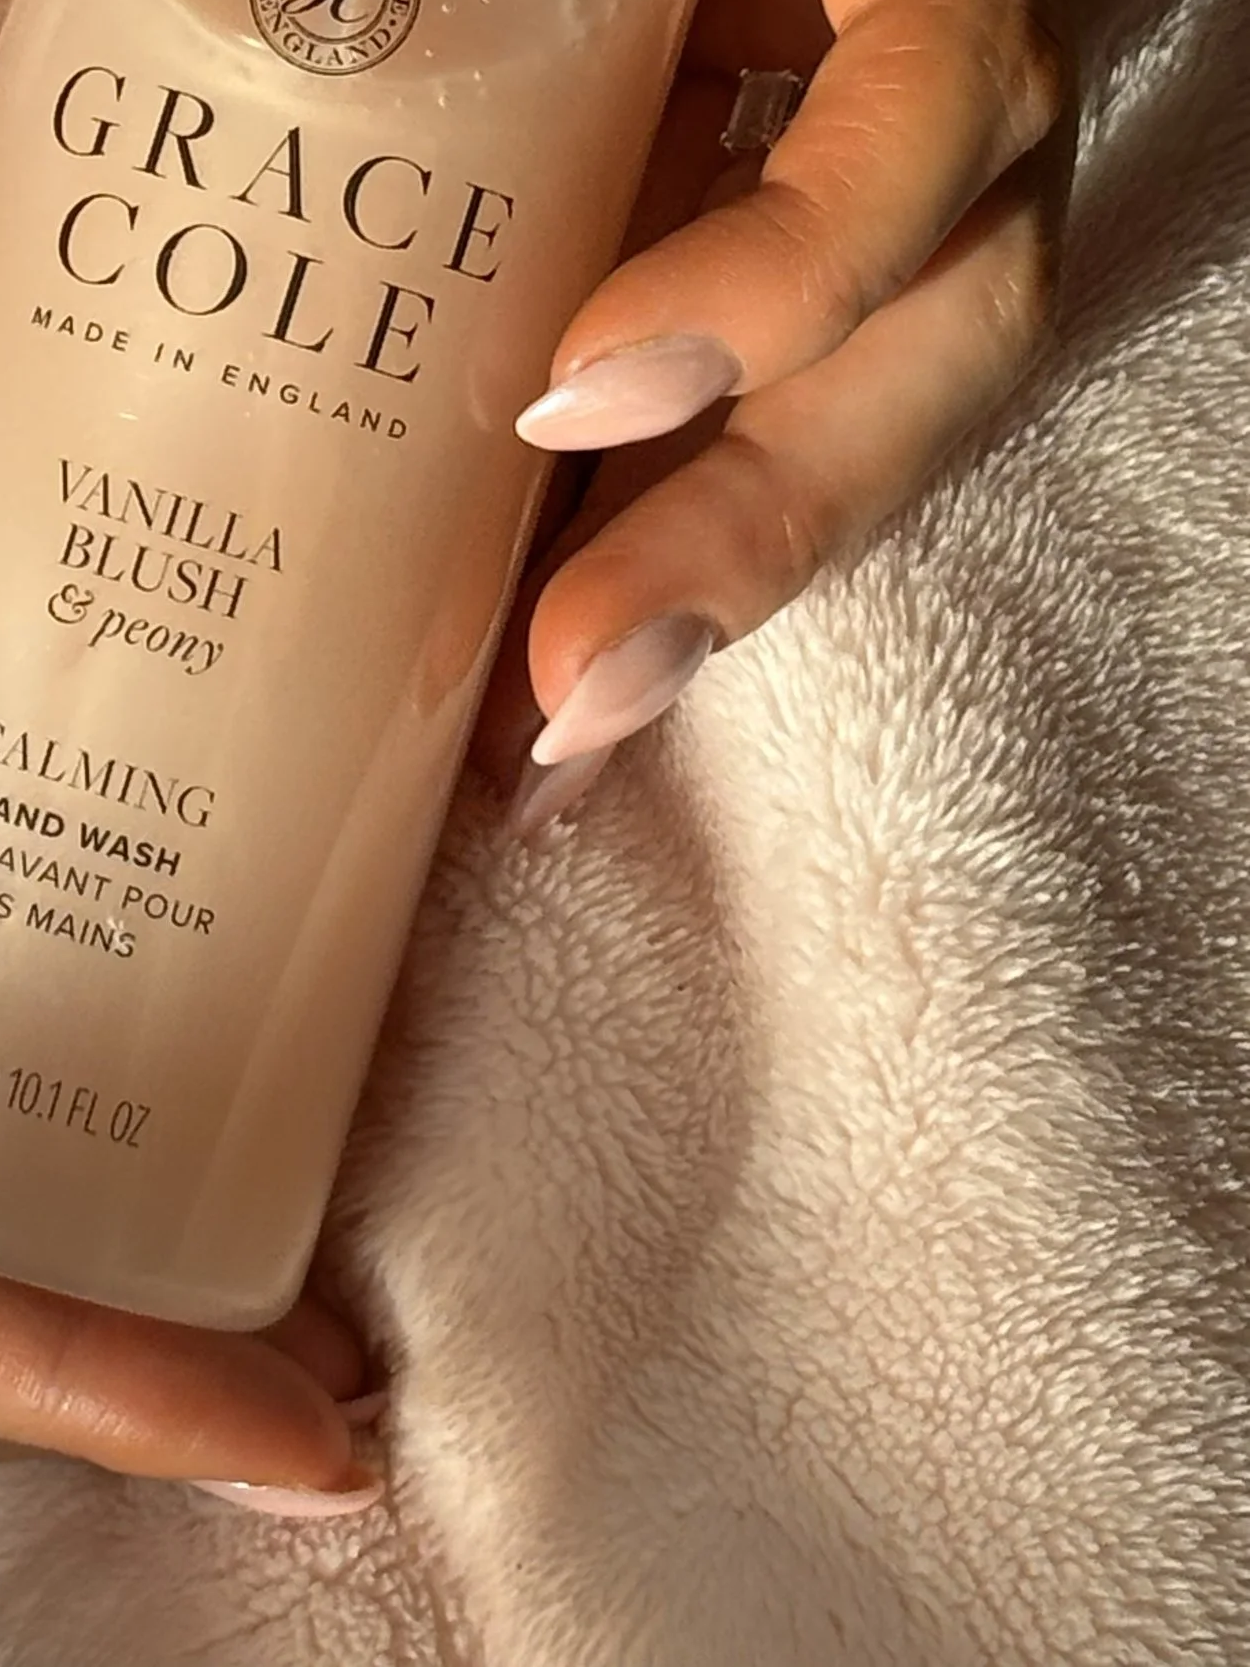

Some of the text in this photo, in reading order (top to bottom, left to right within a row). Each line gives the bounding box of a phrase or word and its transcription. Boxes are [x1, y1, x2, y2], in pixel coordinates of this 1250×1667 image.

[53, 66, 514, 282] GRACE
[58, 193, 435, 383] COLE
[31, 306, 408, 440] MADE IN ENGLAND
[57, 458, 284, 573] VANILLA
[58, 523, 249, 619] BLUSH
[47, 583, 224, 676] & peony
[79, 822, 182, 876] WASH
[26, 903, 137, 958] MAINS
[121, 885, 216, 935] POUR
[7, 1066, 64, 1123] 10.1
[66, 1086, 98, 1136] FL
[110, 1099, 152, 1149] OZ
